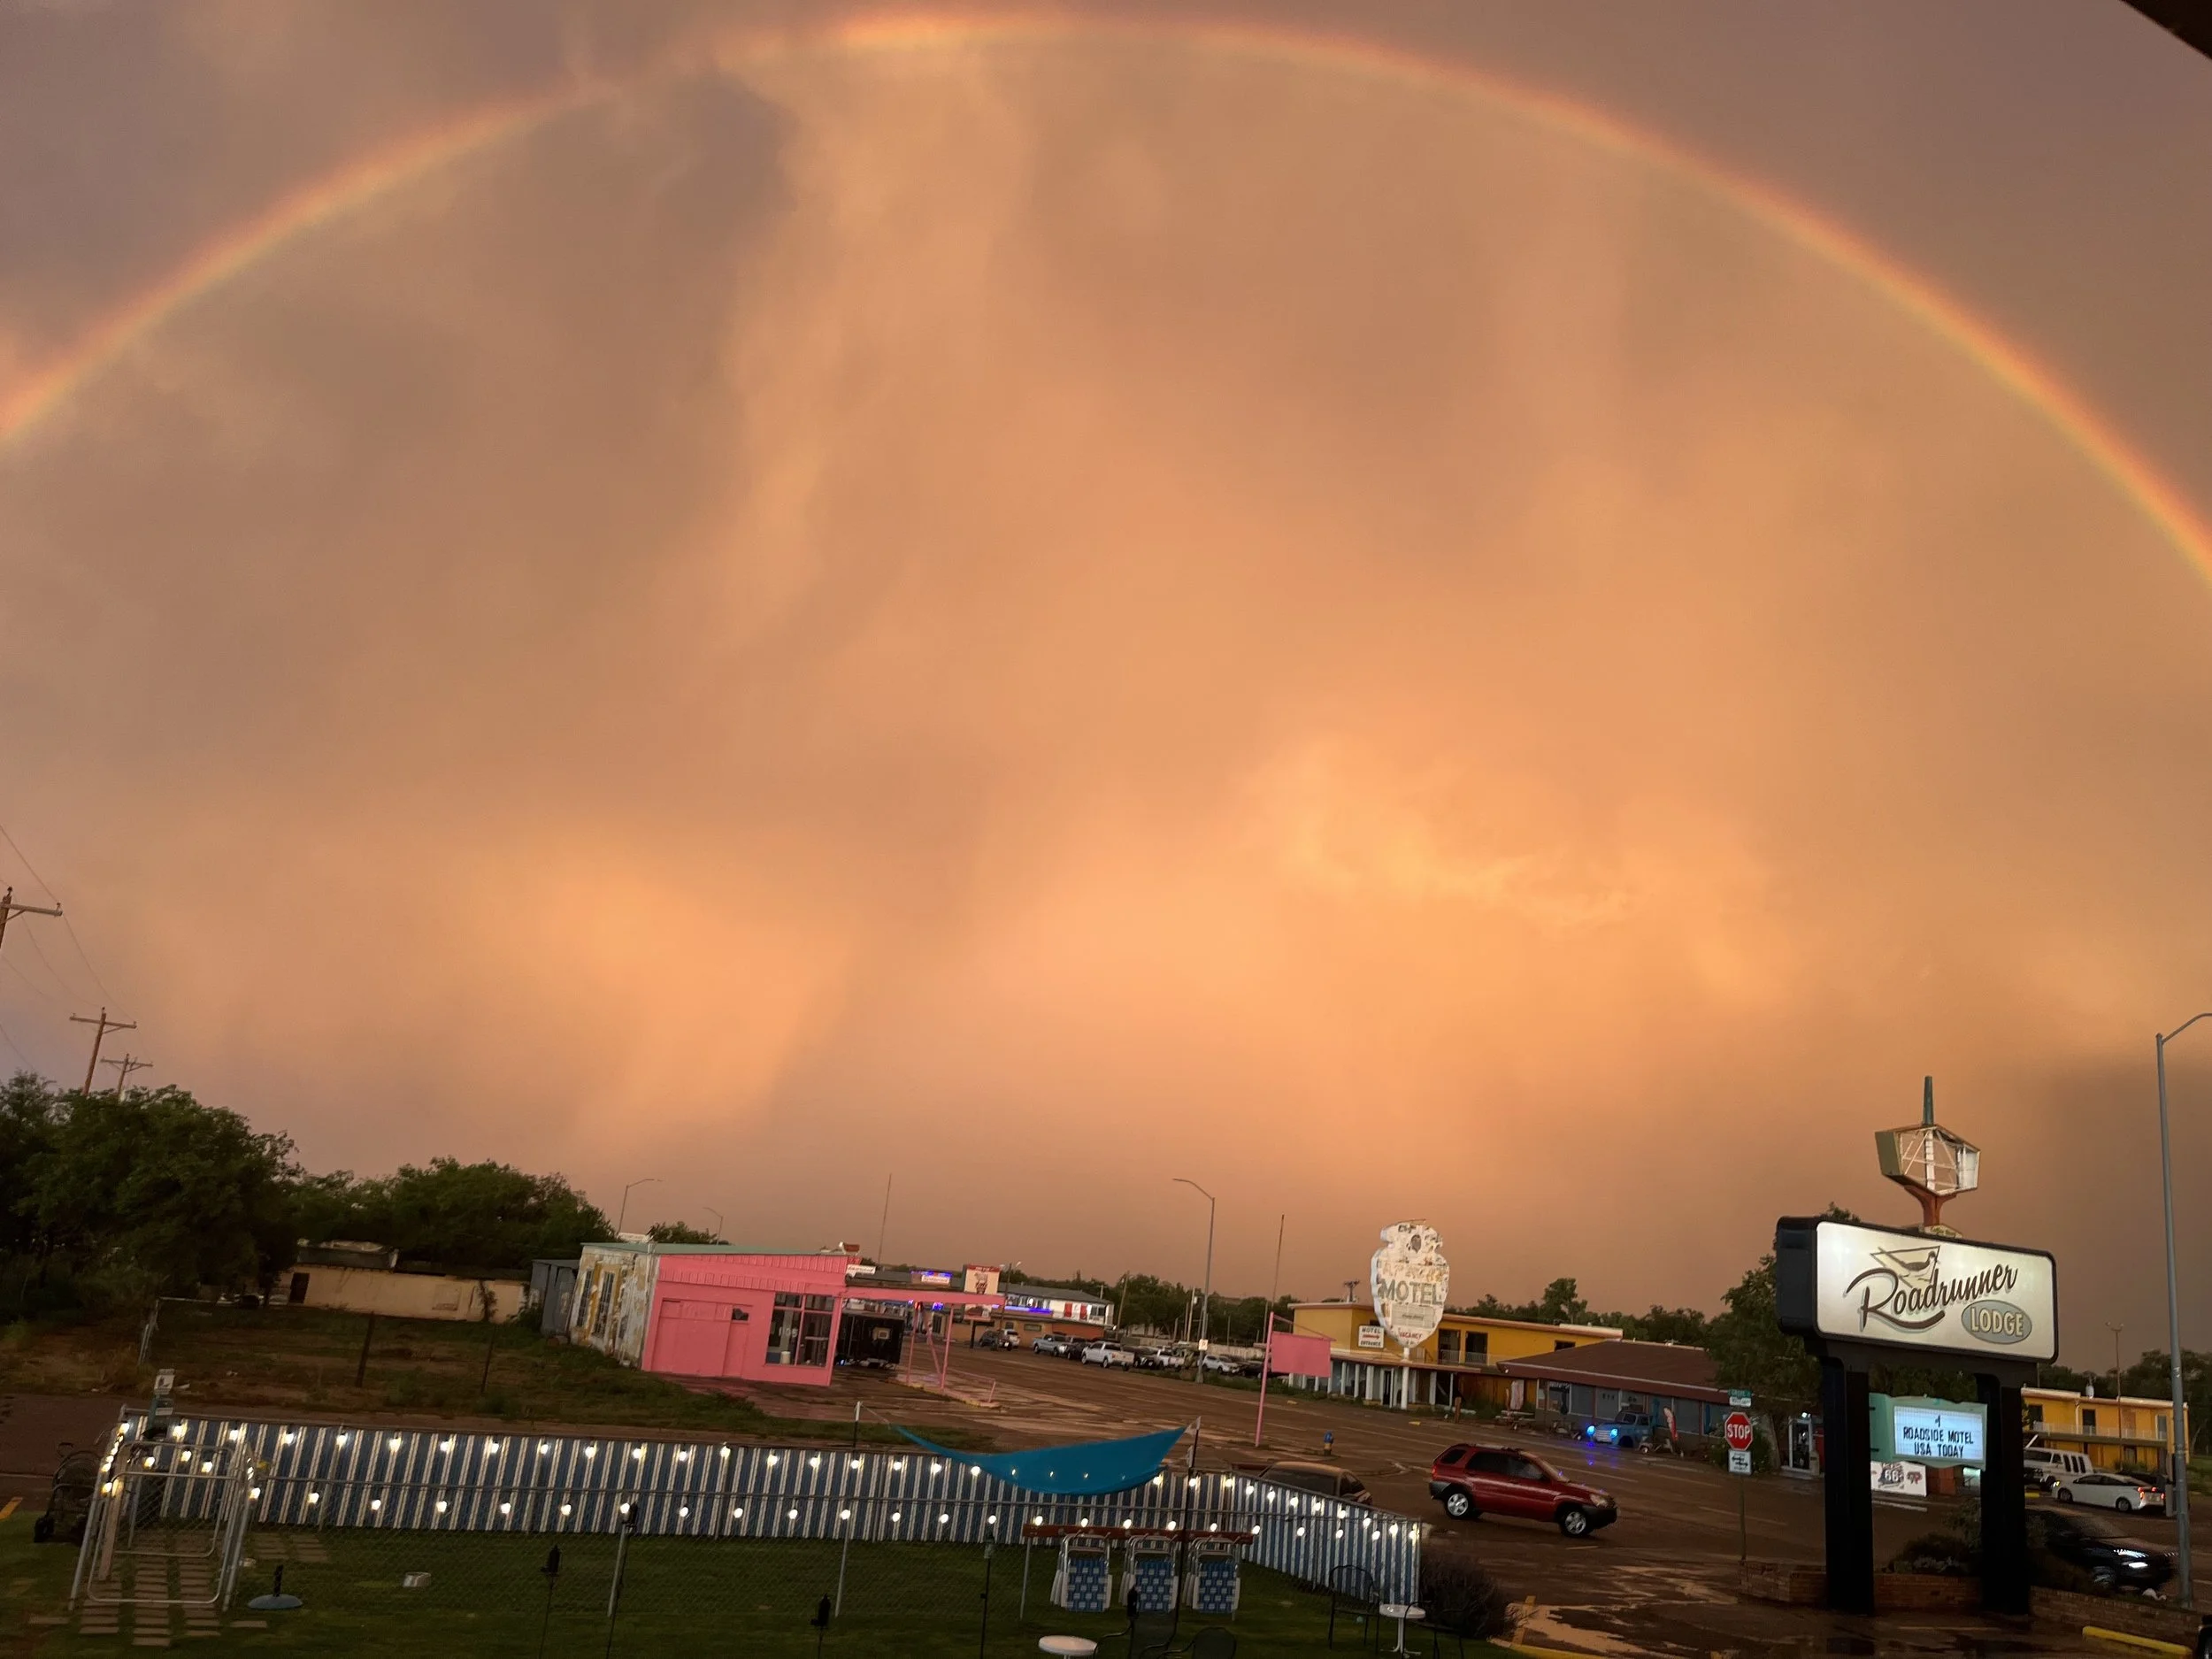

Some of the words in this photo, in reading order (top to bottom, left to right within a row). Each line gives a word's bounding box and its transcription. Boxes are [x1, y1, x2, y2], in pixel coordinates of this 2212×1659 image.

[1377, 1279, 1443, 1306] MOTEL
[1846, 1263, 2018, 1329] Roadrunner
[1970, 1307, 2024, 1337] LODGE
[1399, 1331, 1422, 1340] VACANCY
[1726, 1423, 1751, 1440] STOP
[1903, 1425, 1944, 1442] ROADSIDE
[1947, 1430, 1974, 1445] MOTEL
[1914, 1441, 1932, 1456] USA
[1938, 1443, 1964, 1458] TODAY
